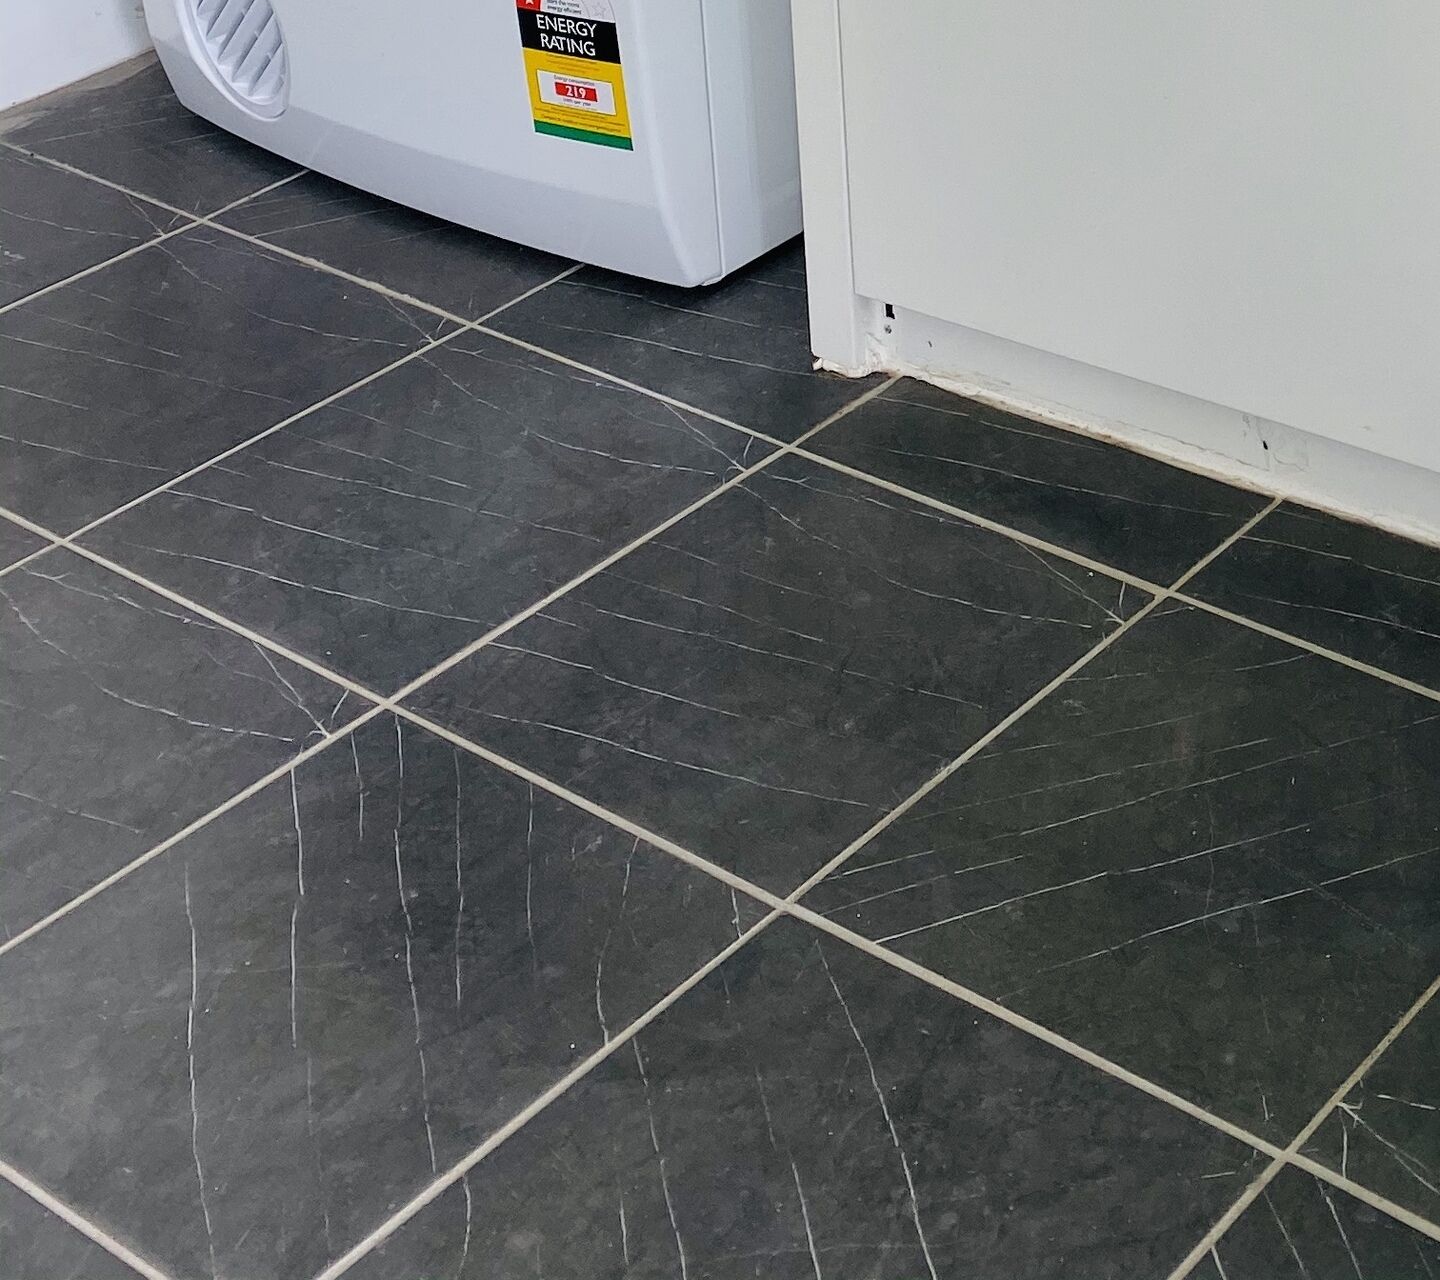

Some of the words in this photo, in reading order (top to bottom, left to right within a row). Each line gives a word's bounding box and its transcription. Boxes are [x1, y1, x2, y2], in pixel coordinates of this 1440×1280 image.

[536, 14, 597, 38] ENERGY
[540, 34, 596, 56] RATING
[565, 86, 586, 98] 219
